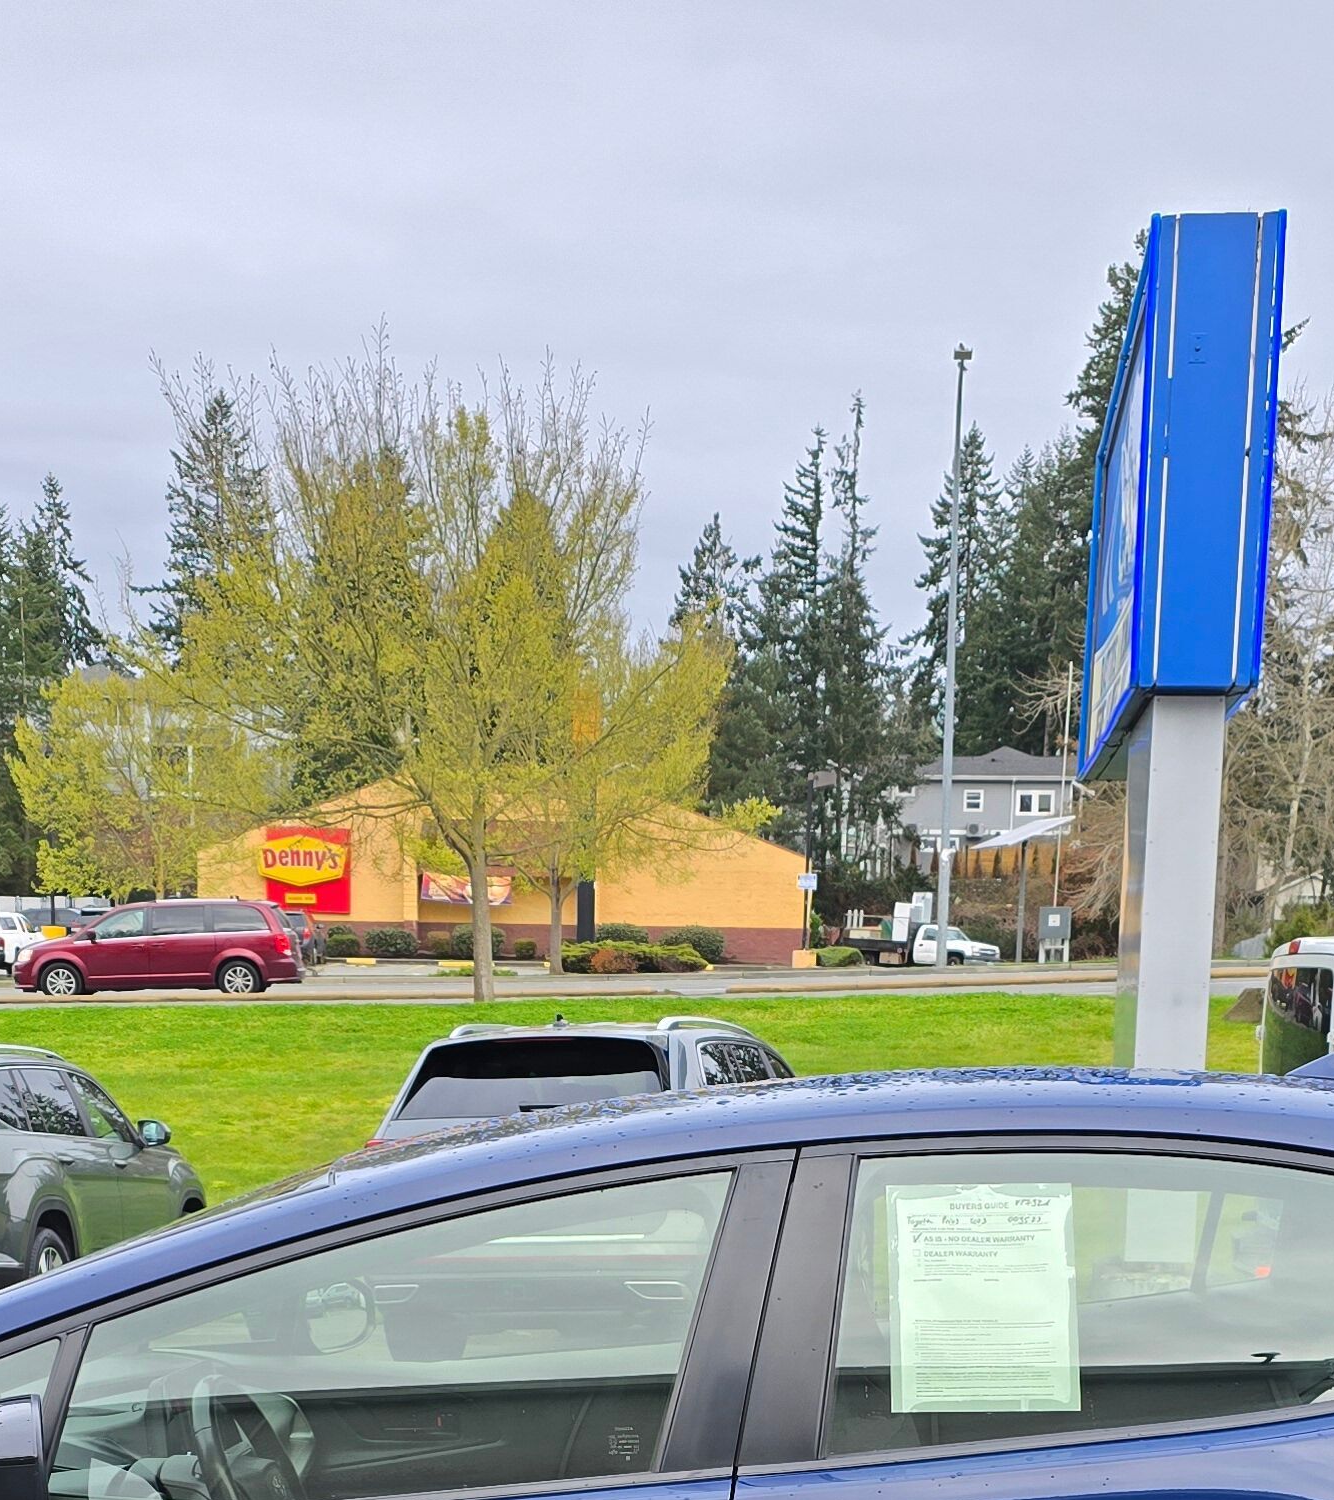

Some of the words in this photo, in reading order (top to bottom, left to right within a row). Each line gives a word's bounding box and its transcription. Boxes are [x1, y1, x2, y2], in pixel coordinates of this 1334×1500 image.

[261, 848, 341, 871] Denny's
[949, 1202, 983, 1210] BUYERS
[984, 1201, 1010, 1210] GUIDE
